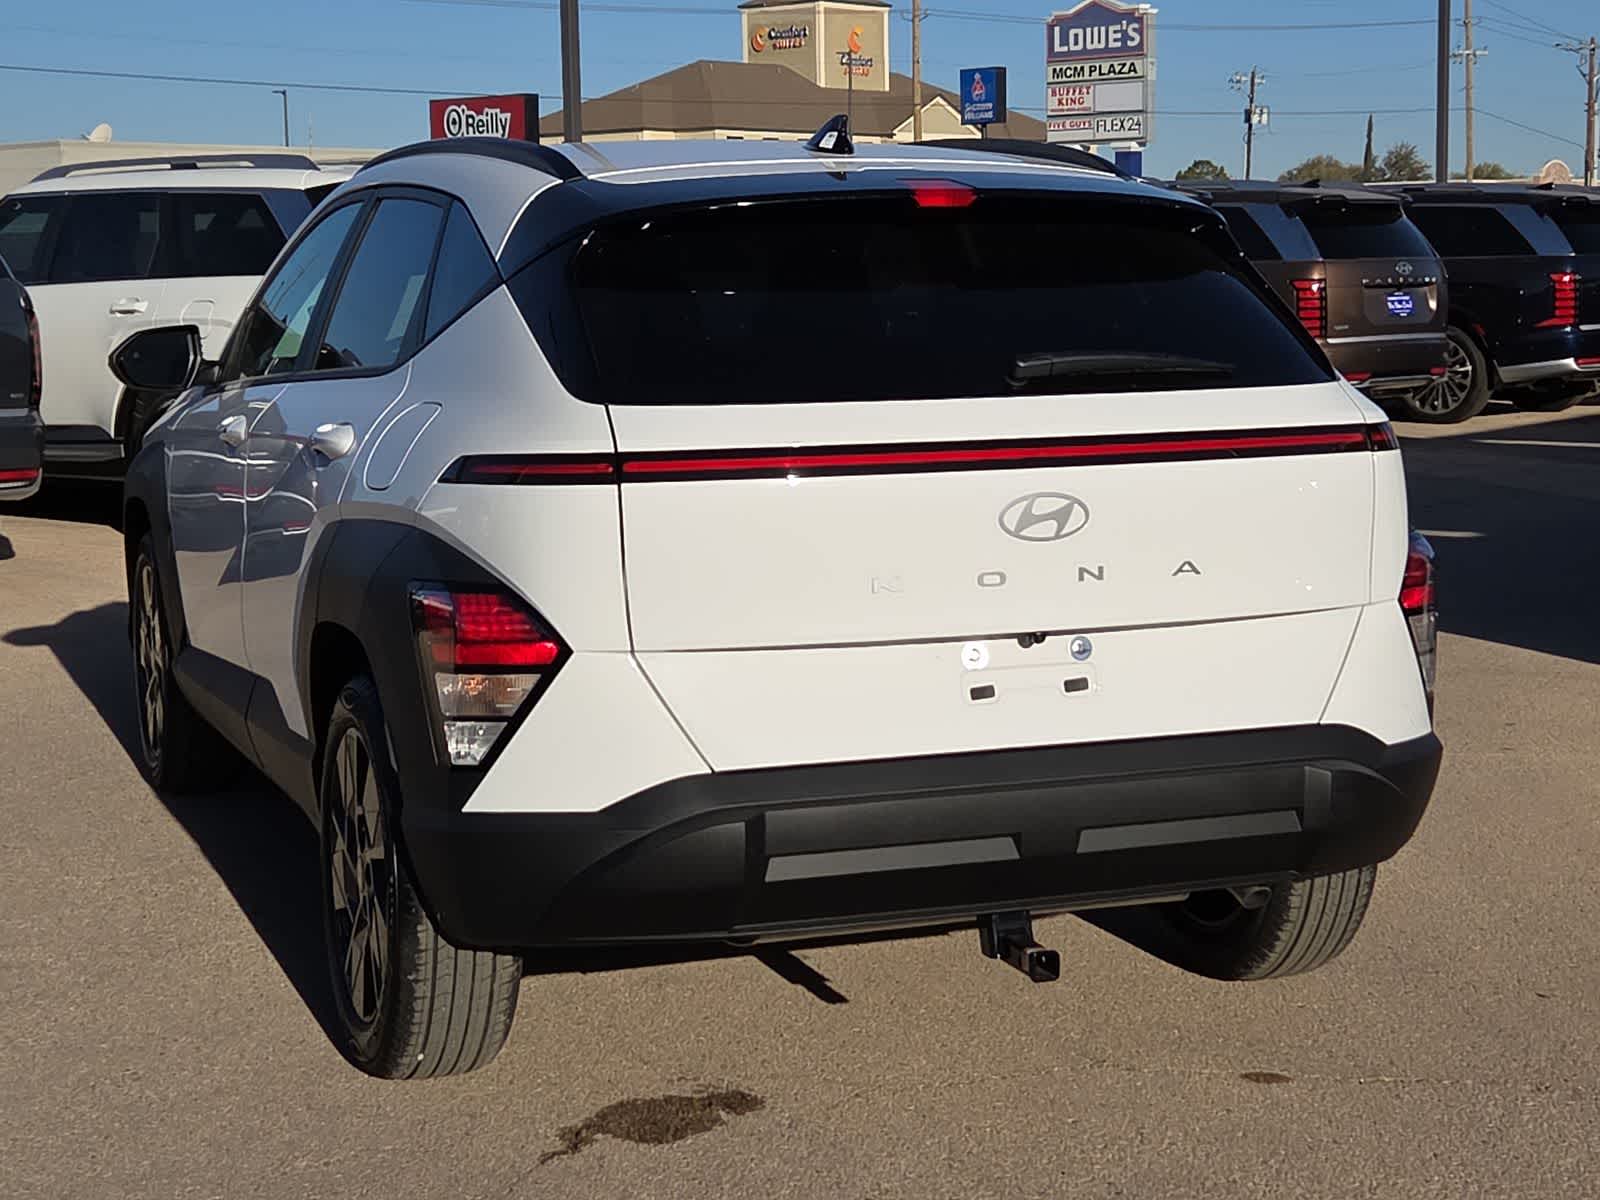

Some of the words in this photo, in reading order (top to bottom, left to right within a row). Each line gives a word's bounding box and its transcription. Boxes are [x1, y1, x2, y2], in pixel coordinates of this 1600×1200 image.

[768, 24, 809, 40] Comfort
[1054, 21, 1141, 53] LOWE'S
[1052, 66, 1085, 80] MCM
[1088, 62, 1138, 77] PLAZA
[1050, 85, 1091, 97] BUFFET
[1057, 97, 1085, 107] KING
[446, 107, 509, 138] O'Reilly
[1048, 120, 1068, 130] FIVE
[1069, 119, 1092, 129] GUYS
[870, 559, 1202, 594] KONA
